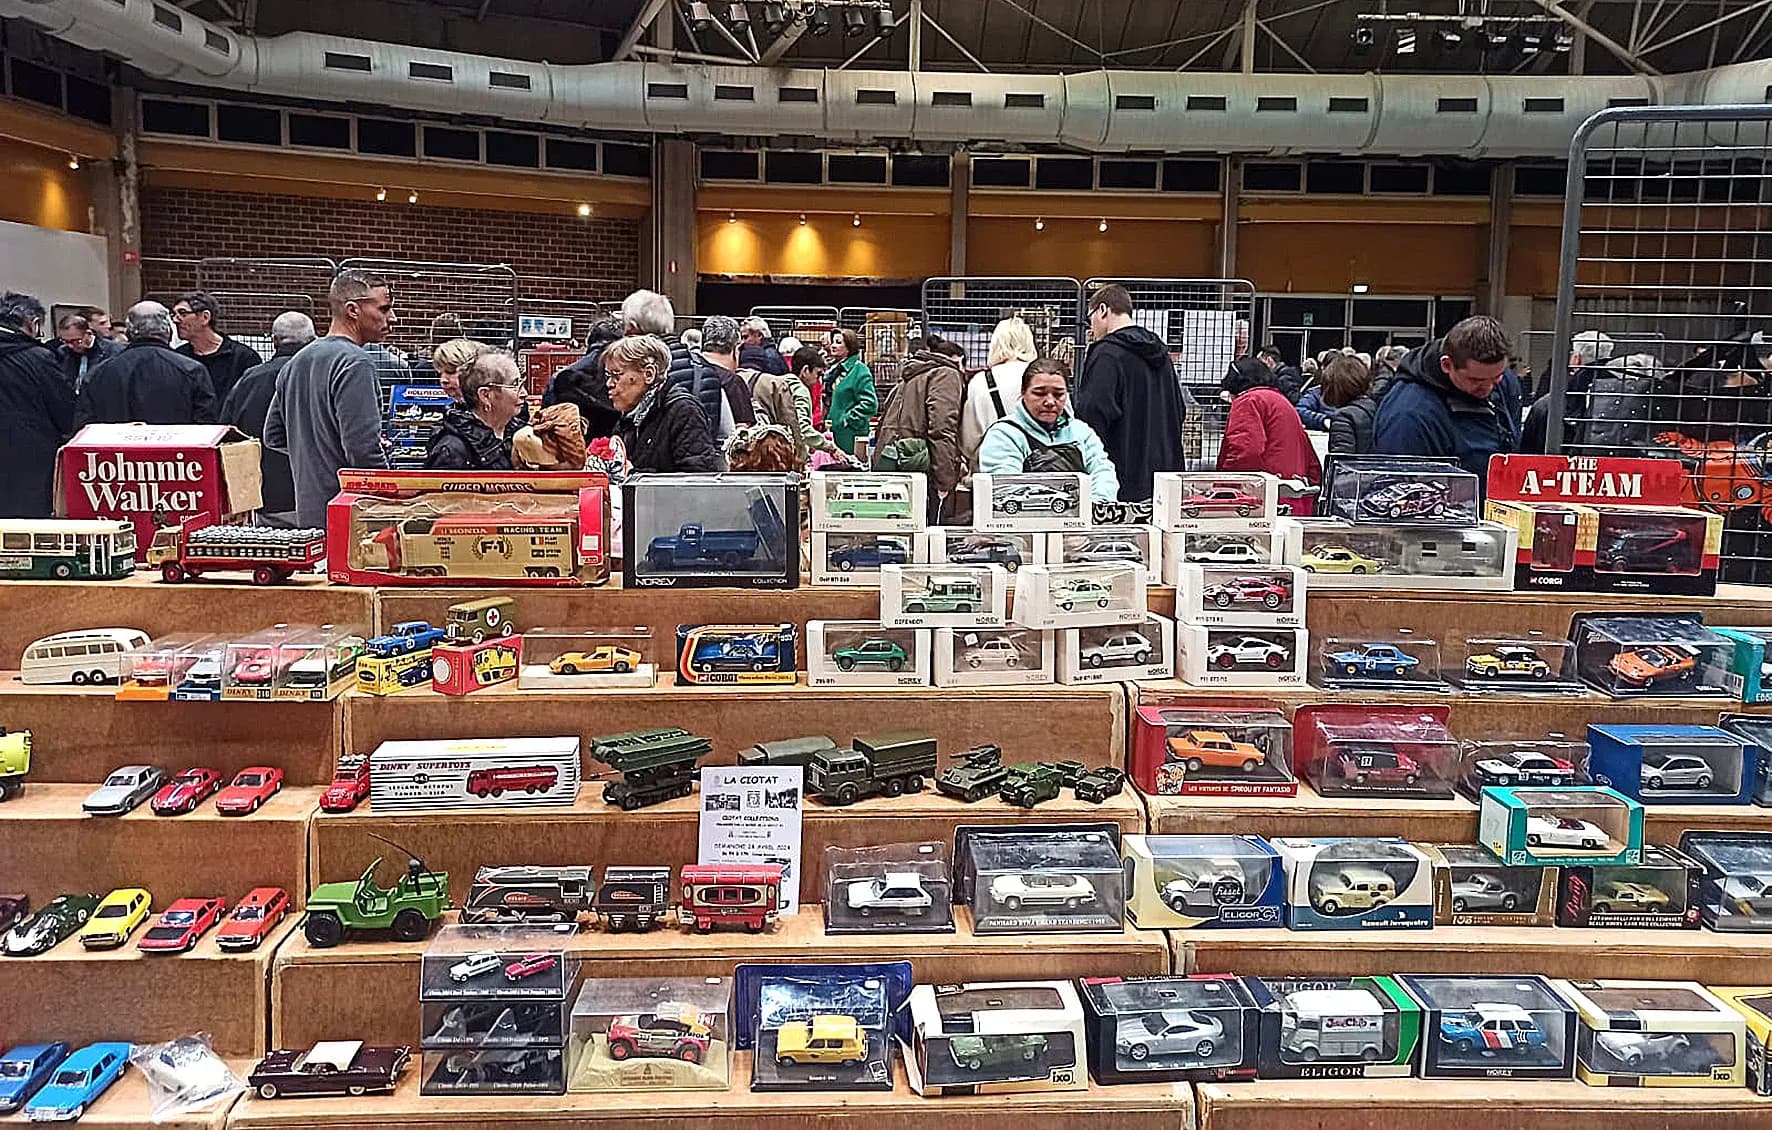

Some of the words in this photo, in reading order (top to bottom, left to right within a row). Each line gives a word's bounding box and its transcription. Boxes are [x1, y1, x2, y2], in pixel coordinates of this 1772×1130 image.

[78, 452, 203, 482] Johnnie
[1567, 457, 1598, 471] THE
[1519, 470, 1643, 498] A-TEAM
[80, 482, 203, 512] Walker
[635, 578, 677, 586] NOREV
[1538, 576, 1562, 585] CORGI
[709, 673, 738, 682] CORGI
[379, 762, 411, 771] DINKY
[416, 761, 473, 770] SUPERTOYS
[723, 776, 737, 785] LA
[740, 776, 779, 785] CIOTAT
[1231, 785, 1252, 793] SPIROU
[1224, 910, 1259, 919] ELIGOR
[1052, 1071, 1071, 1083] ixo
[1300, 1067, 1362, 1077] ELIGOR
[1712, 1070, 1730, 1081] ixo
